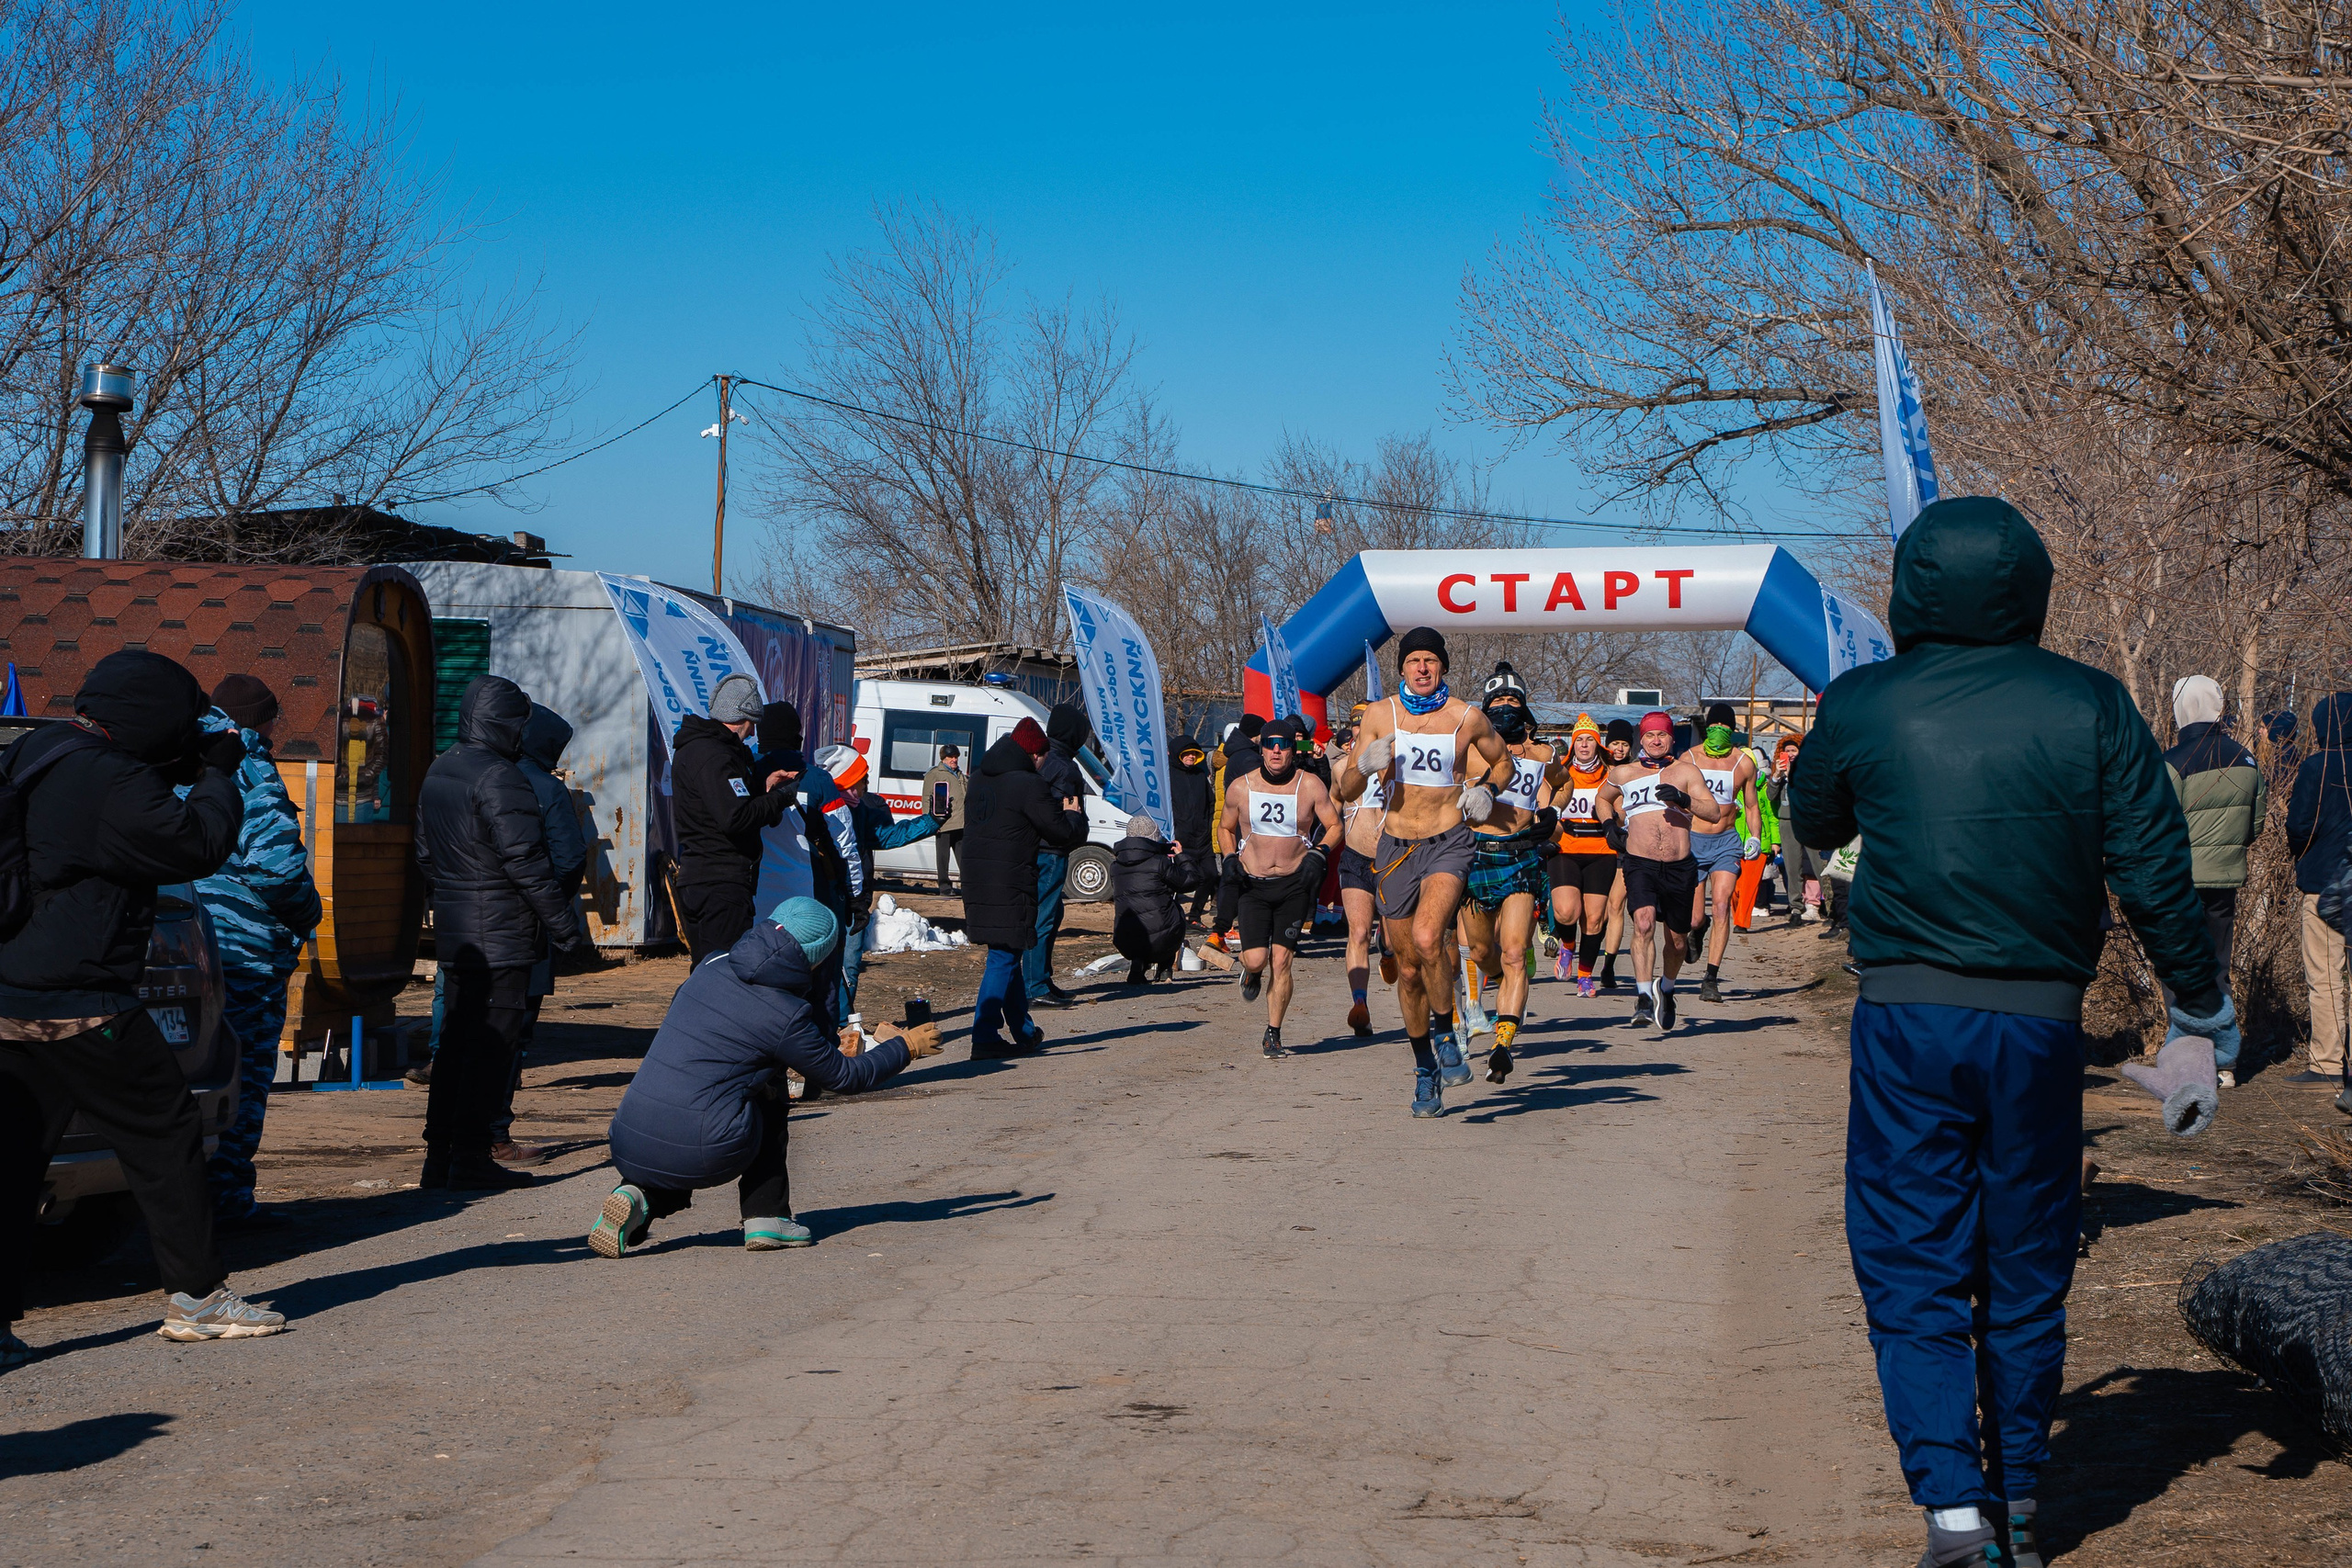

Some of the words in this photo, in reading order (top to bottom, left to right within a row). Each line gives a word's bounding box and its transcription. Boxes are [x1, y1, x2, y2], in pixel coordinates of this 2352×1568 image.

[1437, 569, 1694, 615] СТАРТ
[1410, 746, 1442, 773] 26
[1373, 778, 1384, 797] 2
[1508, 770, 1535, 796] 28
[1706, 779, 1725, 795] 24
[886, 798, 922, 810] ПОМО
[1568, 797, 1589, 814] 30
[1630, 786, 1650, 807] 27
[1260, 802, 1284, 824] 23
[138, 985, 187, 998] STER
[162, 1010, 187, 1031] 134
[169, 1032, 181, 1041] RUS
